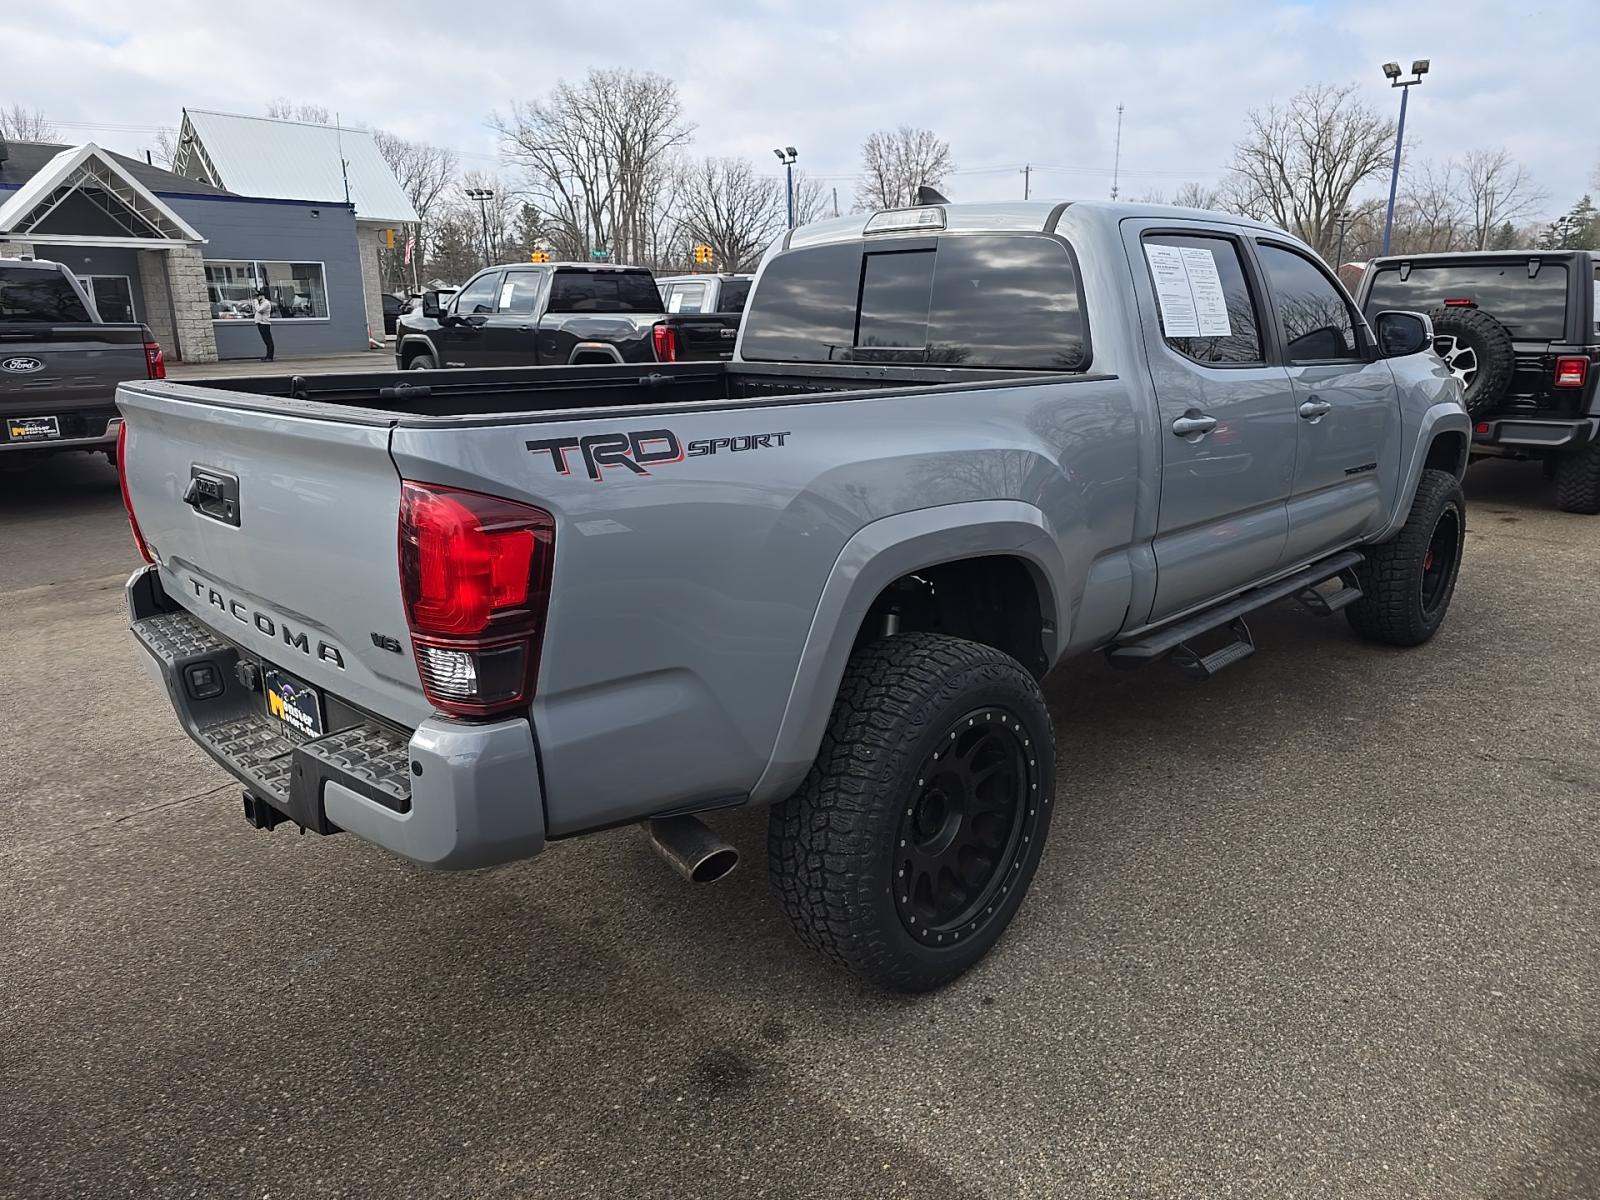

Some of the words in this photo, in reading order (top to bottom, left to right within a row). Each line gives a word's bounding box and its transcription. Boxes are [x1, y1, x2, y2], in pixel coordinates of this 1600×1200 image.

[525, 428, 685, 482] TRD
[687, 431, 791, 458] SPORT
[189, 576, 346, 671] TACOMA
[370, 631, 403, 654] V6
